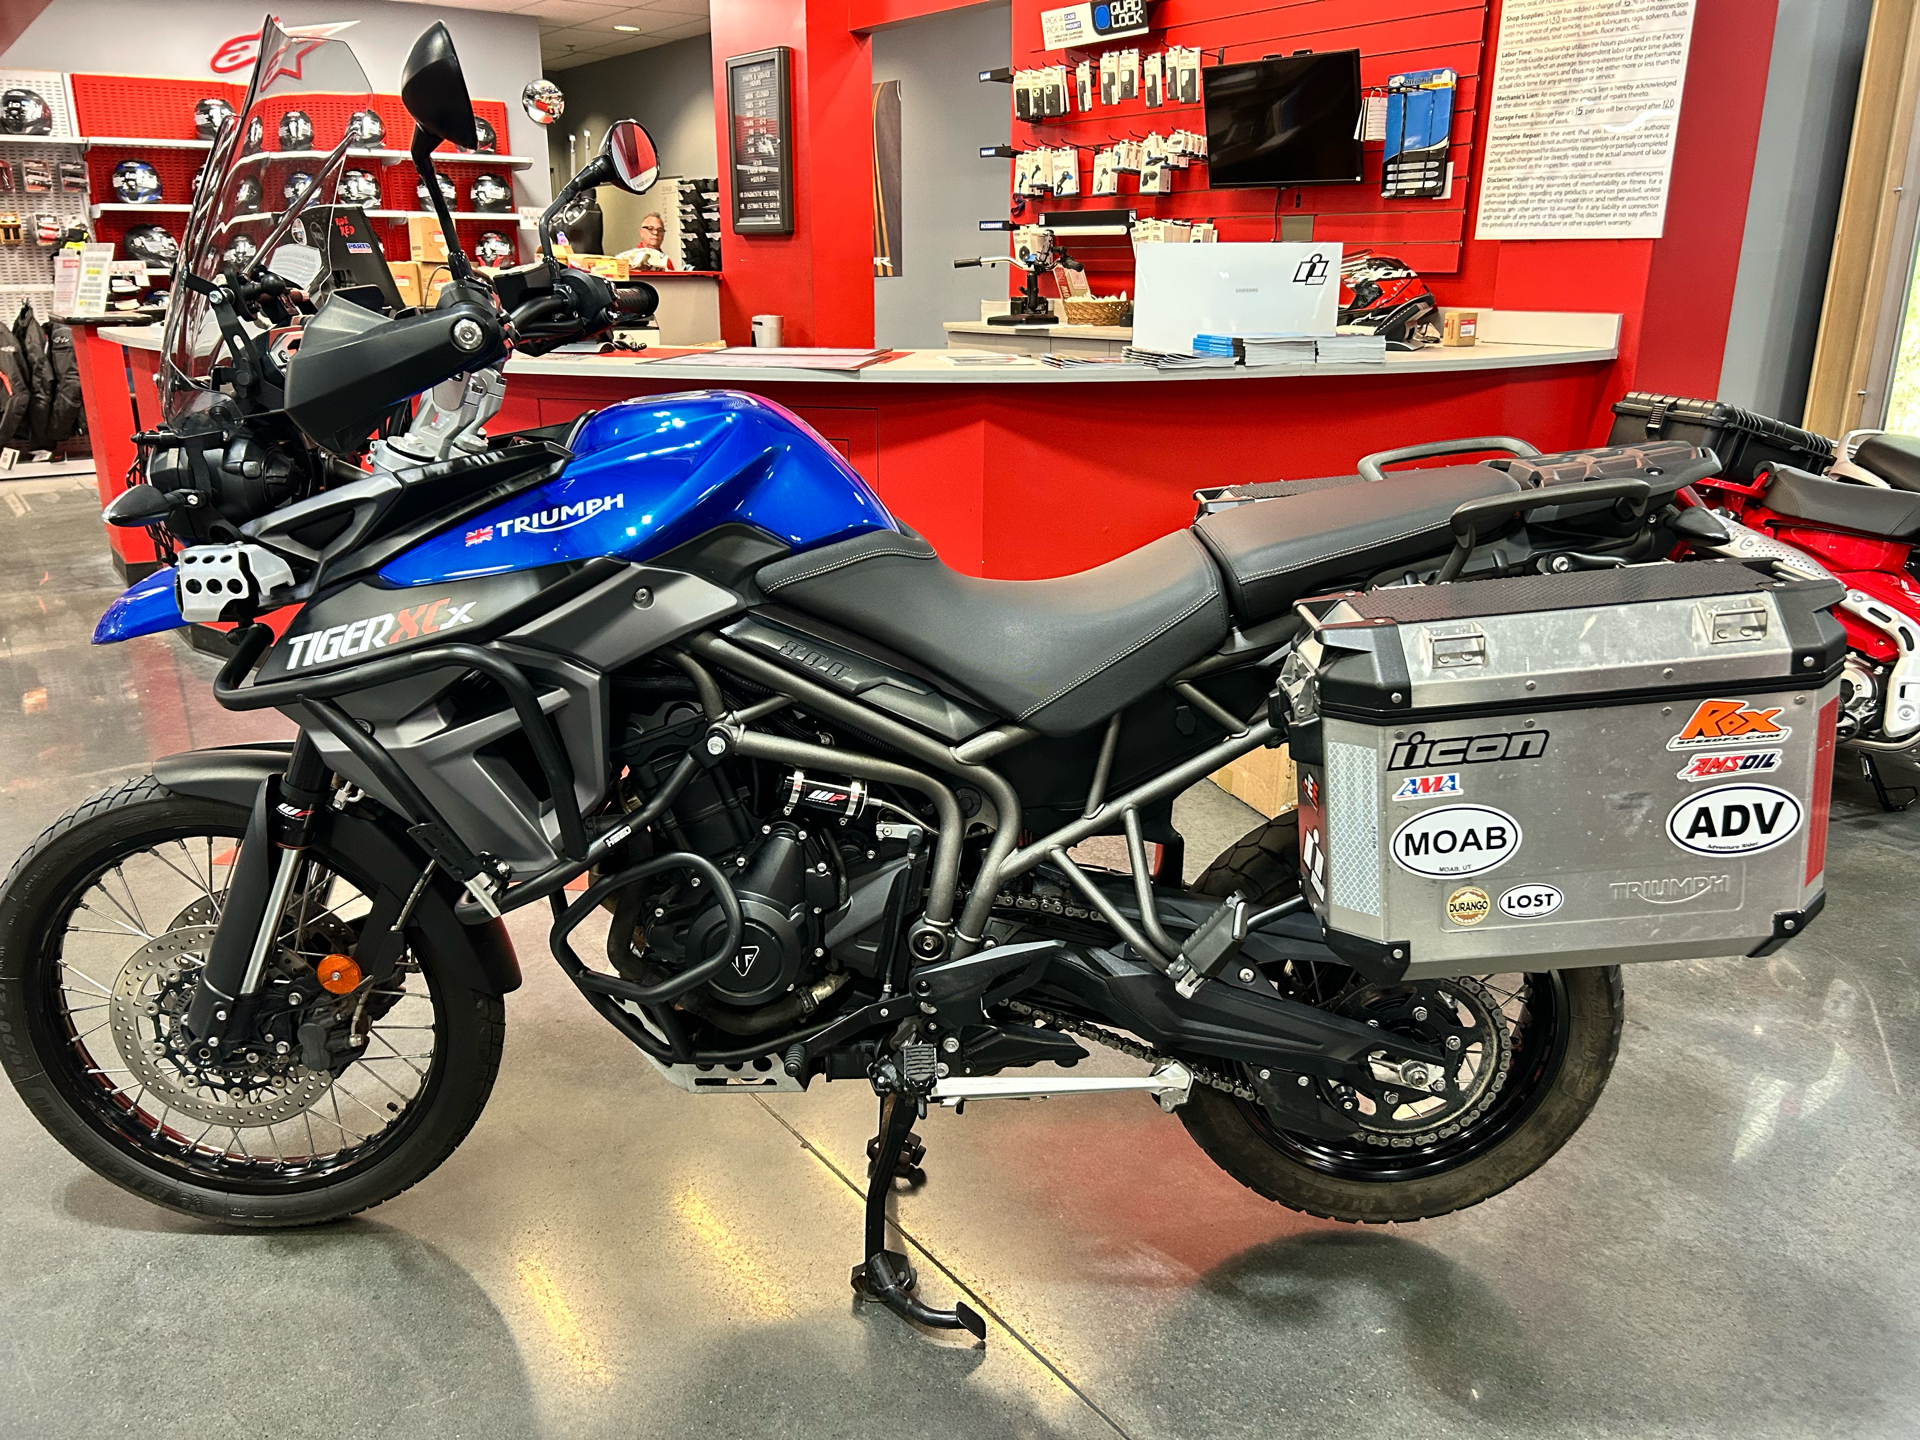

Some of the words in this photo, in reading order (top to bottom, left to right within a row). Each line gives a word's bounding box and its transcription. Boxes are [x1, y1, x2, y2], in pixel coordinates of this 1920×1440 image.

[1110, 0, 1142, 15] QUAD
[1656, 1, 1688, 10] connection
[1111, 11, 1143, 28] LOCK
[1645, 50, 1681, 60] performance
[1558, 76, 1572, 85] given
[1497, 92, 1526, 101] Mechanic's
[1636, 79, 1677, 89] acknowledged
[1624, 102, 1647, 110] charged
[1492, 132, 1521, 140] Incomplete
[339, 225, 355, 238] RED
[496, 493, 624, 537] TRIUMPH
[286, 613, 395, 670] TIGER
[778, 640, 852, 680] 800
[1687, 753, 1776, 777] AMSOIL
[1398, 774, 1458, 796] AMA
[808, 790, 848, 802] WP
[1685, 801, 1785, 840] ADV
[1404, 826, 1507, 856] MOAB
[1610, 874, 1730, 904] TRIUMPH
[1450, 900, 1488, 913] DURANGO
[1508, 894, 1554, 909] LOST
